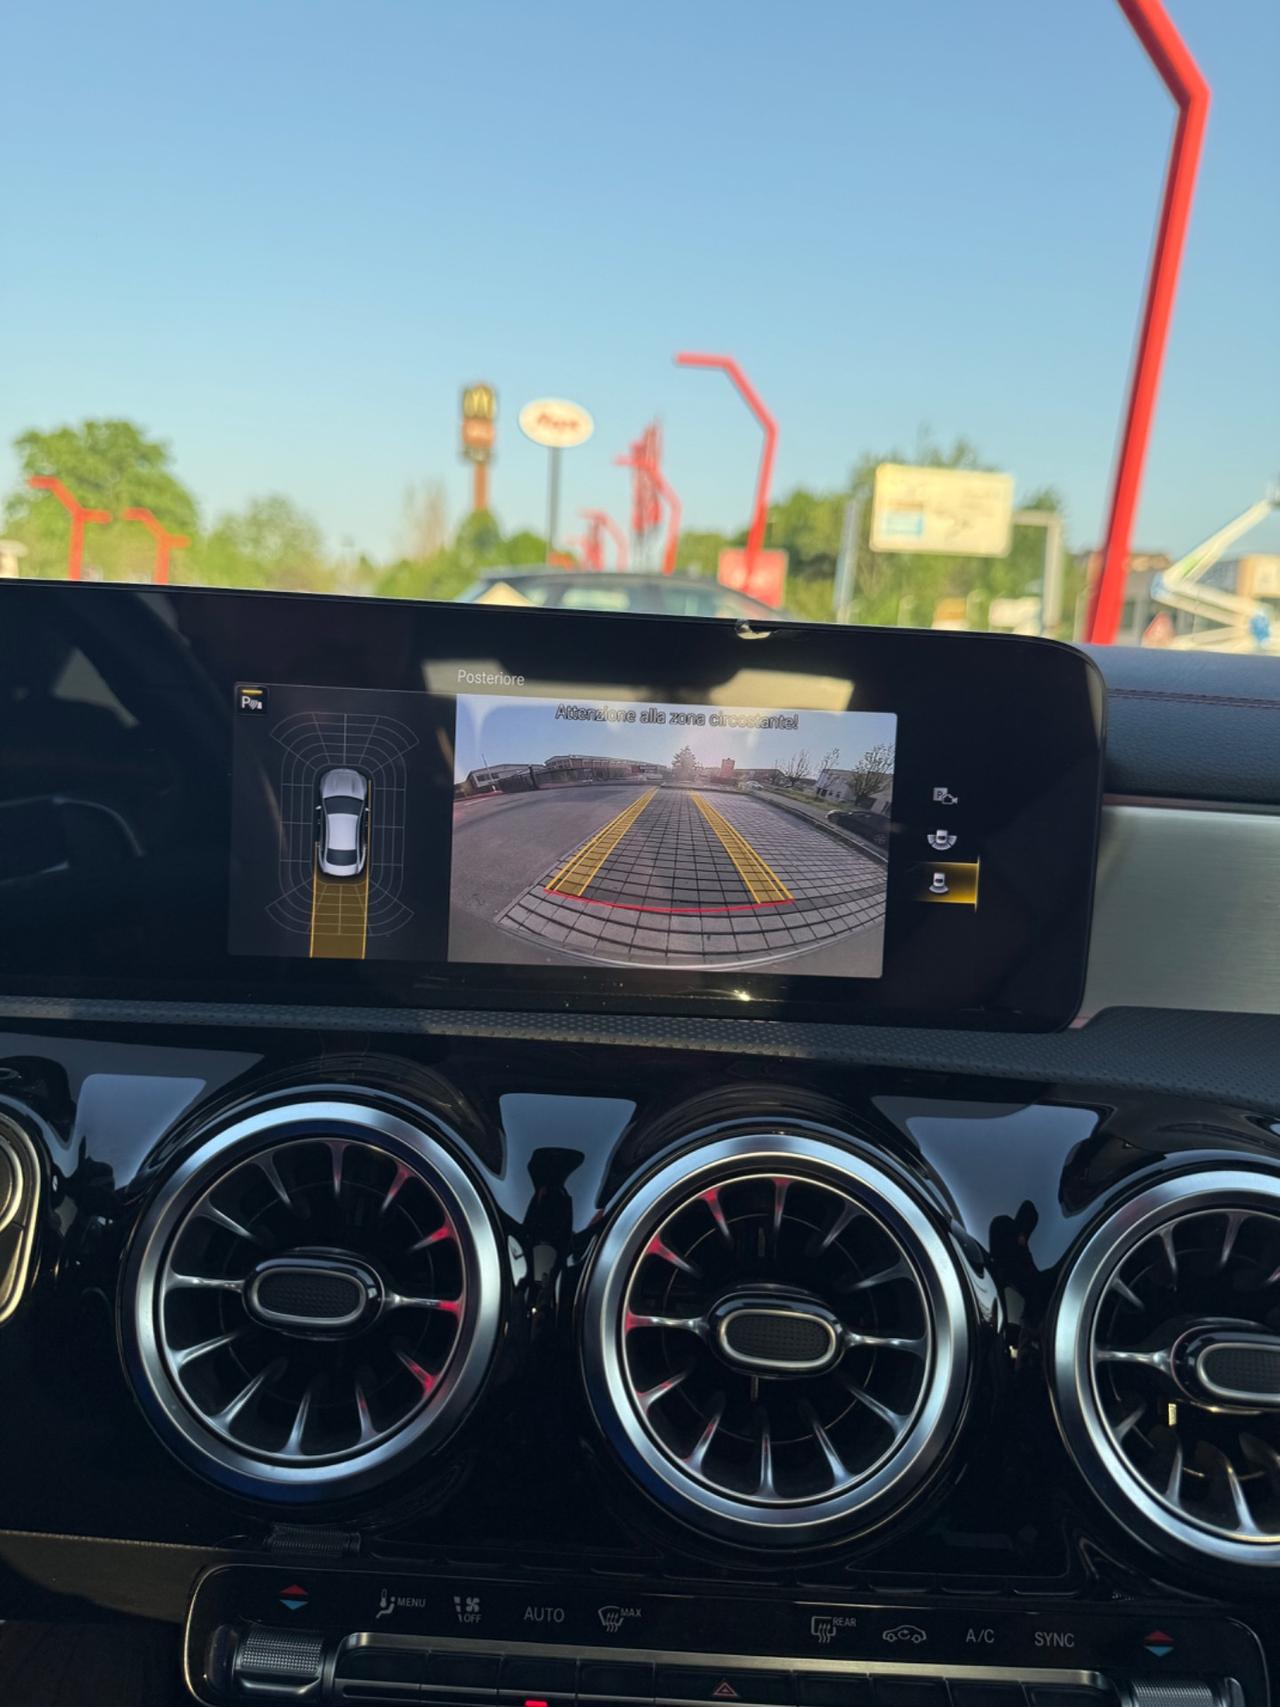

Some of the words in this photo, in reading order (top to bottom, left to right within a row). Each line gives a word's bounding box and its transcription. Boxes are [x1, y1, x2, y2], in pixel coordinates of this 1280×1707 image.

[457, 669, 525, 687] Posteriore
[555, 703, 636, 723] Attenzione
[639, 707, 667, 725] alla
[669, 711, 706, 727] zona
[397, 1597, 426, 1608] MENU
[463, 1614, 482, 1623] OFF
[523, 1606, 565, 1623] AUTO
[620, 1607, 642, 1618] MAX
[832, 1616, 857, 1627] REAR
[966, 1629, 995, 1644] A/C
[1034, 1631, 1075, 1648] SYNC
